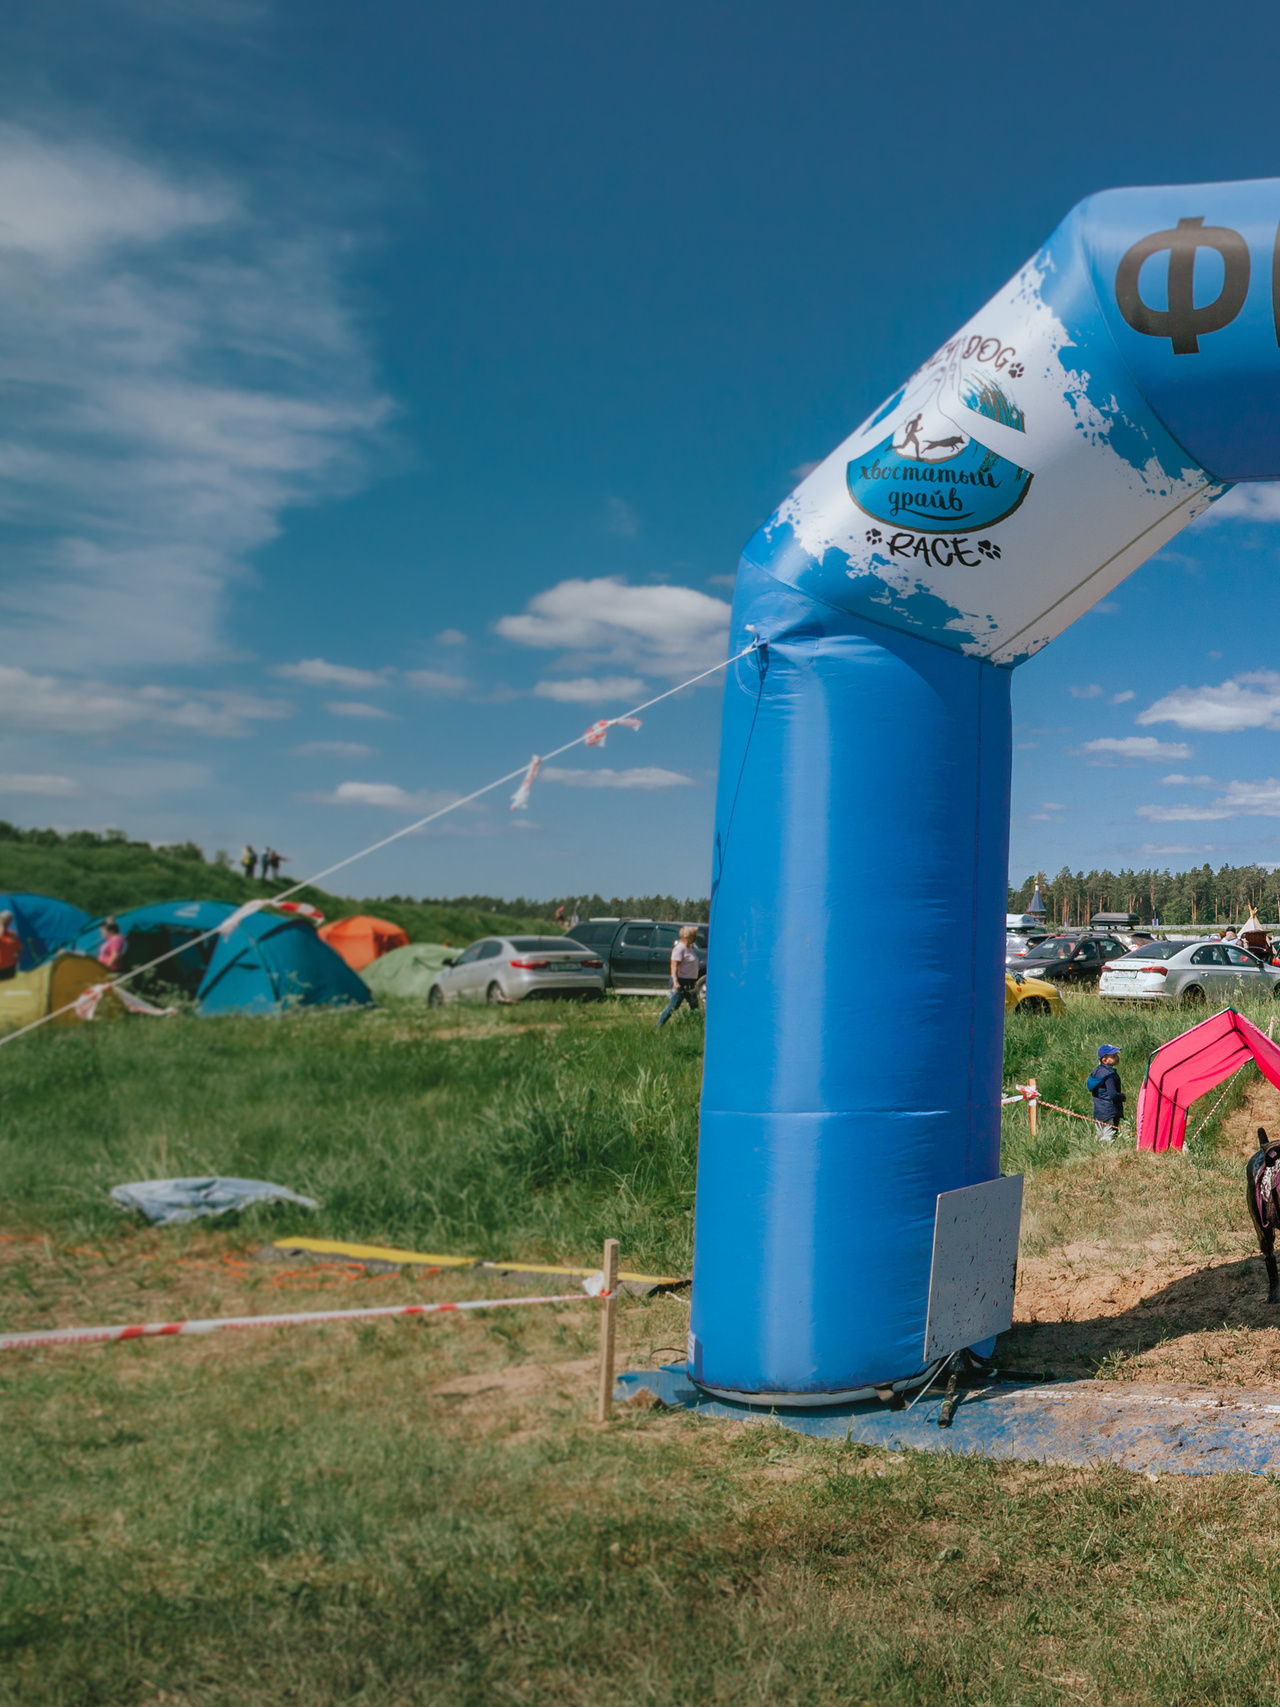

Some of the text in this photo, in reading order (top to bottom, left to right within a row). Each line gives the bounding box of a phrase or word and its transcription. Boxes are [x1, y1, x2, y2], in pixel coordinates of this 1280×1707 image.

[962, 335, 1016, 372] DOG
[858, 459, 1003, 489] хвостатый
[888, 487, 964, 517] драйв
[886, 532, 982, 568] RACE
